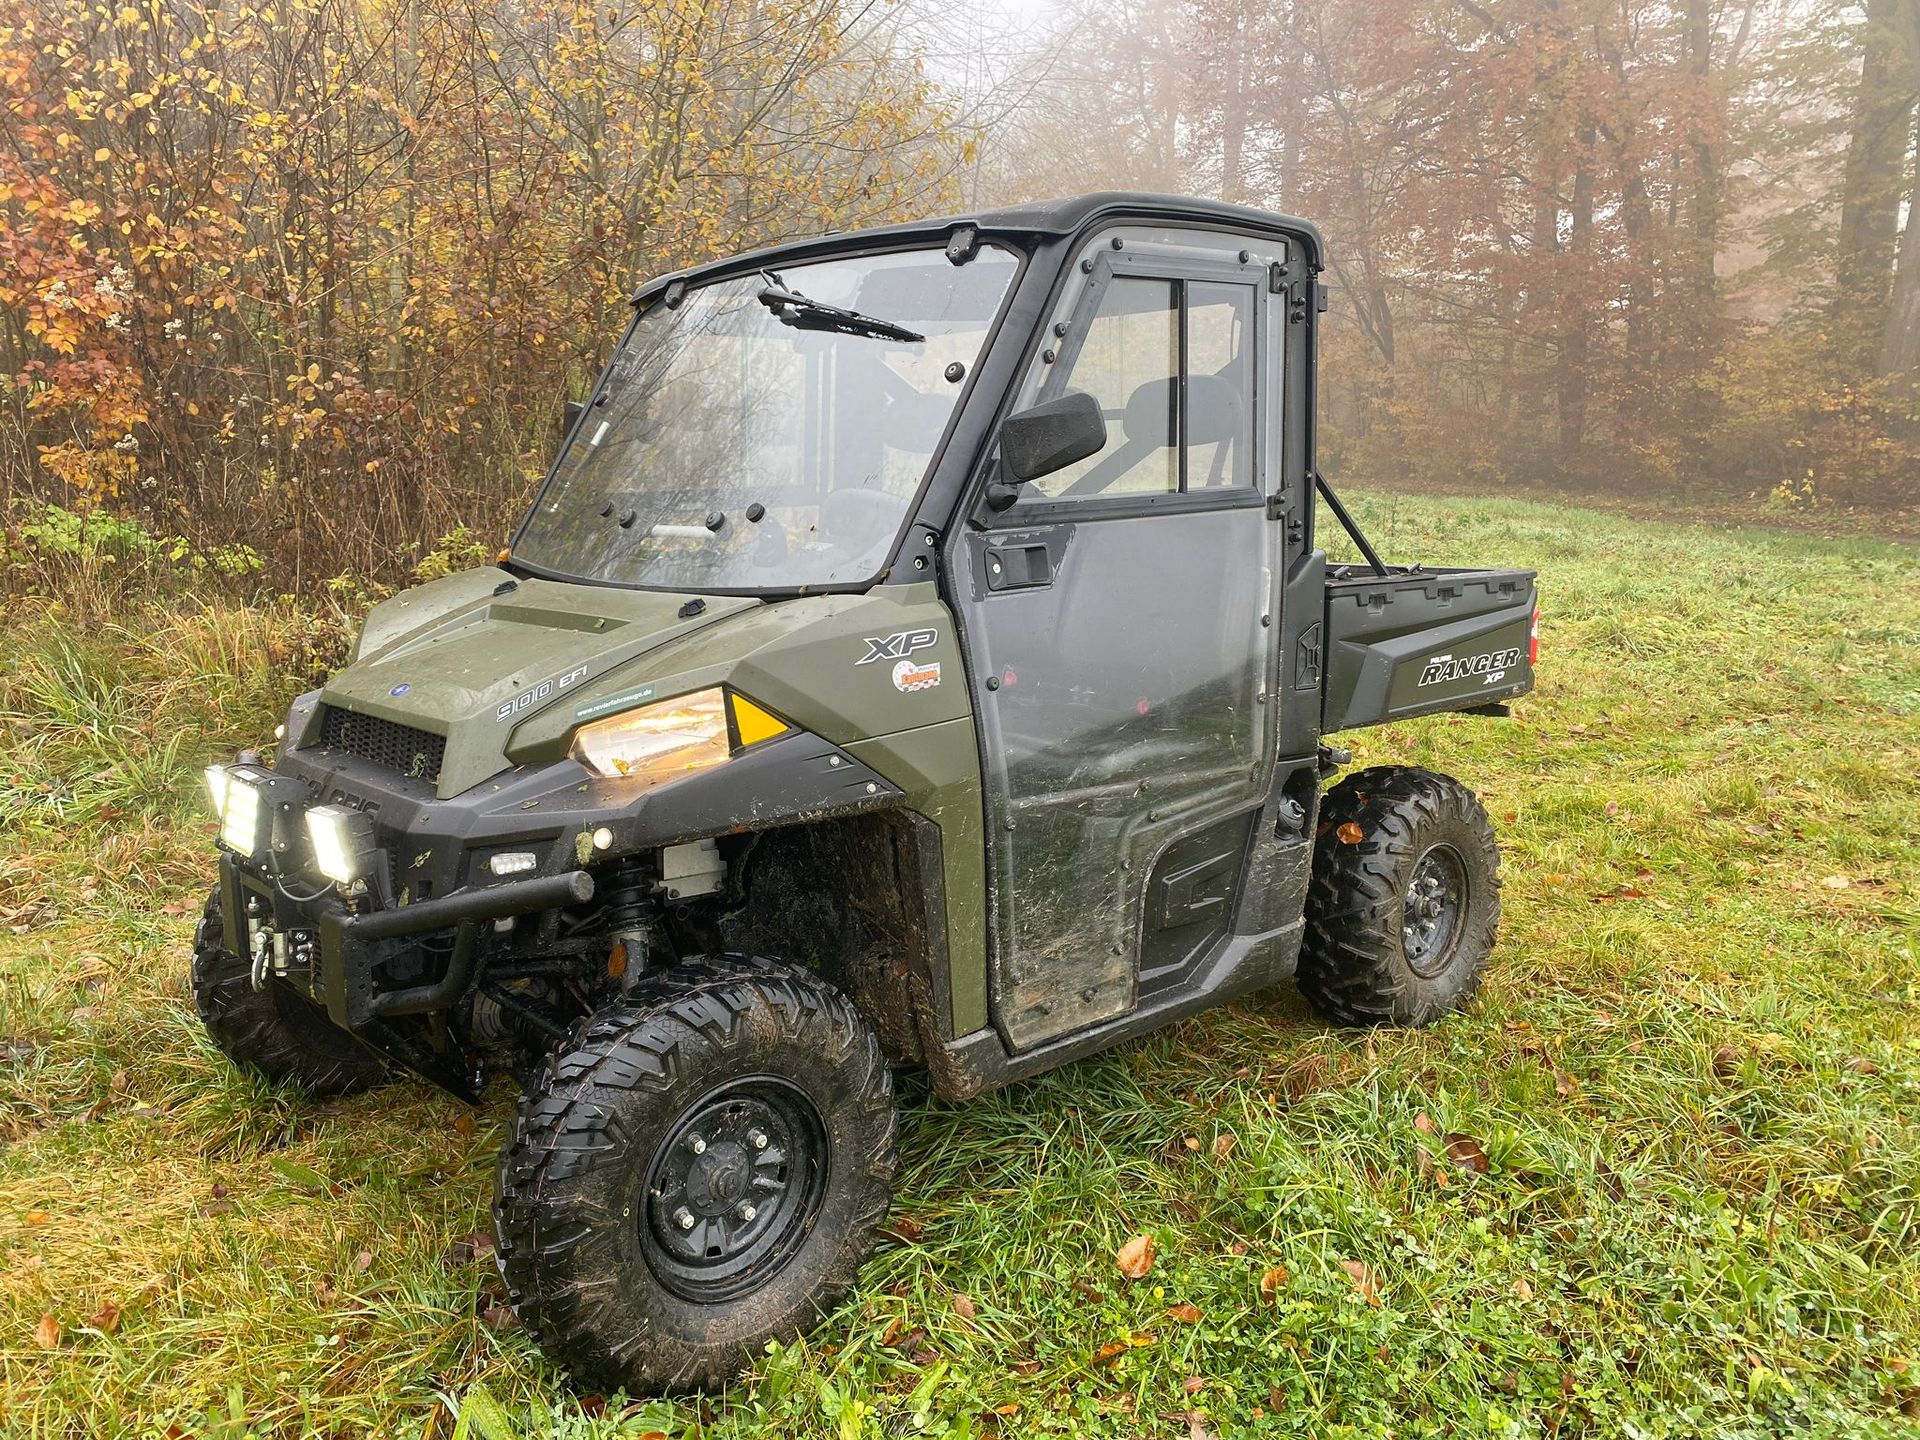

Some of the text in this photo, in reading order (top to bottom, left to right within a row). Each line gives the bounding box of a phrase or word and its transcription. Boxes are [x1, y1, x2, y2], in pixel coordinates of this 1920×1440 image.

[855, 628, 937, 665] XP
[1430, 654, 1453, 665] POLARIS
[1418, 648, 1521, 687] RANGER
[1483, 671, 1505, 685] XP
[496, 665, 588, 722] 900 EFI
